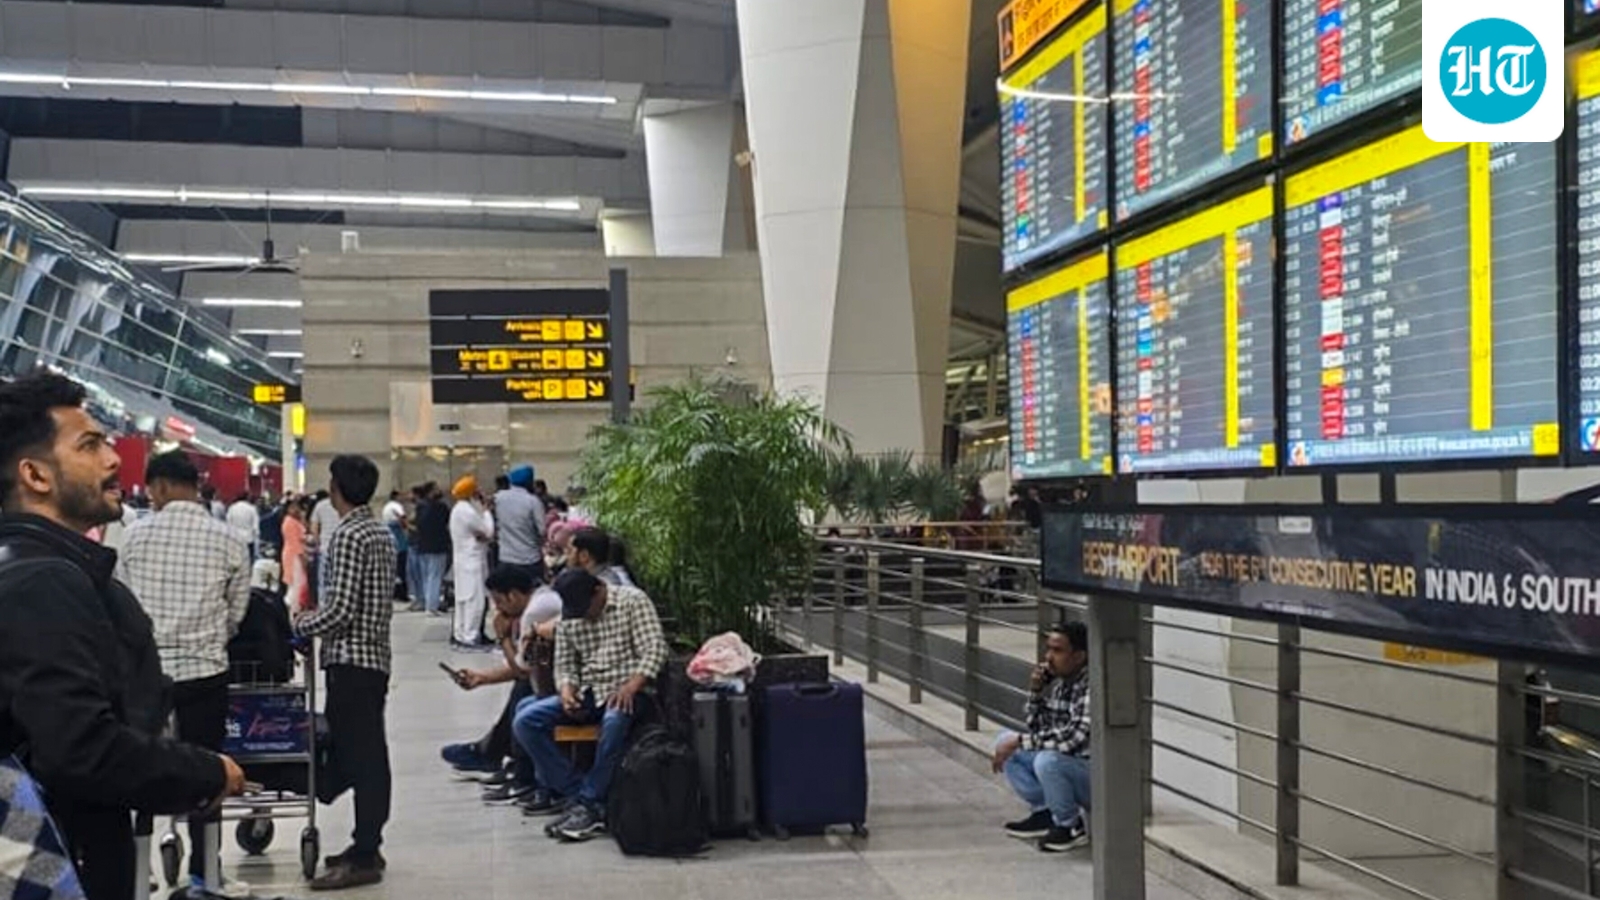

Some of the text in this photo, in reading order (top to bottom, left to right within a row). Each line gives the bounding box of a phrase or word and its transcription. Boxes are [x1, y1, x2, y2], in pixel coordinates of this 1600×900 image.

[1083, 541, 1115, 577] BEST
[1116, 544, 1181, 587] AIRPORT
[1225, 554, 1250, 584] THE
[1269, 555, 1367, 593] CONSECUTIVE
[1369, 563, 1416, 598] YEAR
[1425, 567, 1443, 601] IN
[1446, 568, 1498, 607] INDIA
[1503, 572, 1517, 609] &
[1520, 573, 1600, 616] SOUTH
